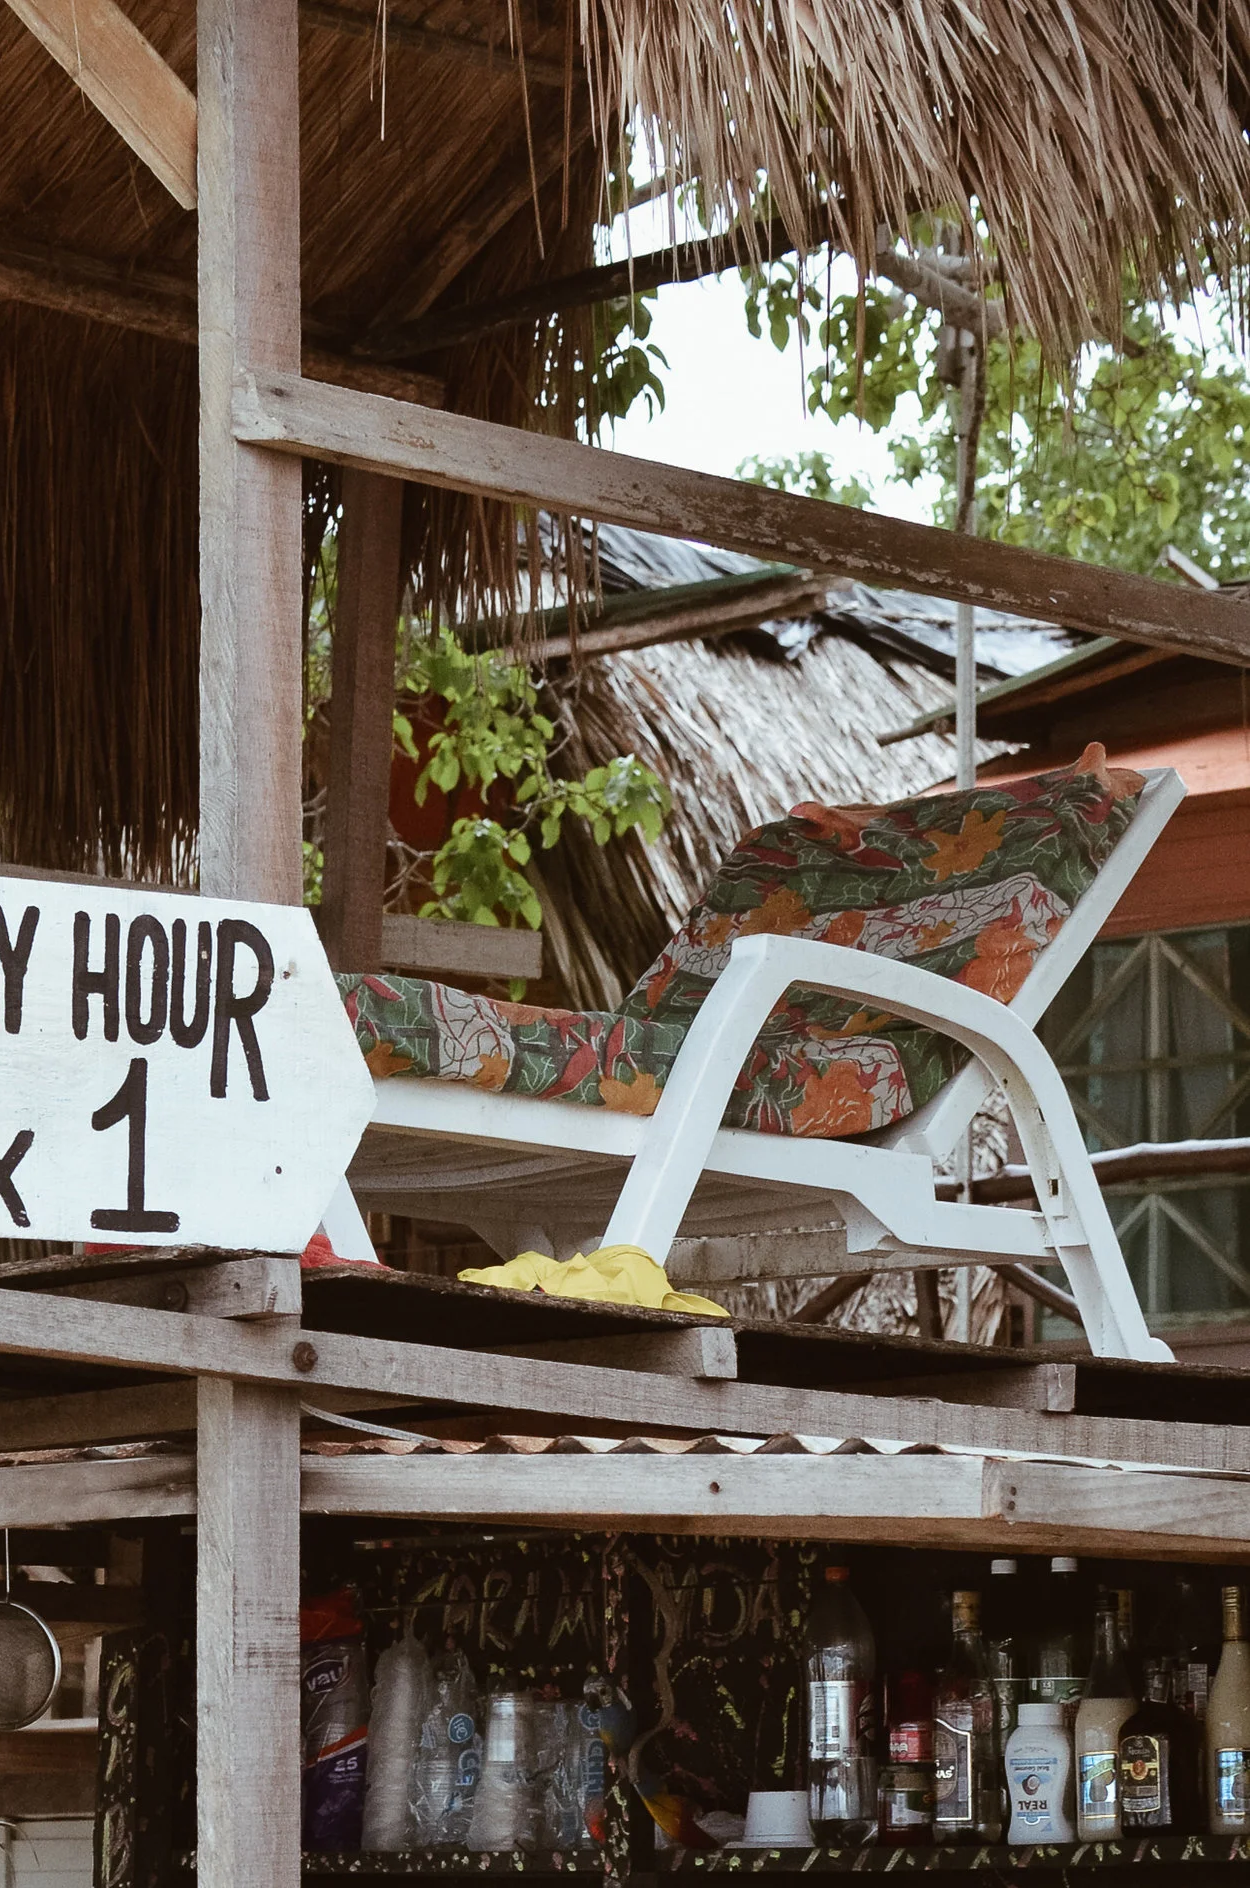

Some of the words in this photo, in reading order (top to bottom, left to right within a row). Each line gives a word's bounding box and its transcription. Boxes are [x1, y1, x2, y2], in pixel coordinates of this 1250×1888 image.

[72, 909, 275, 1102] HOUR
[91, 1057, 180, 1233] 1
[334, 1756, 358, 1771] 25
[1018, 1800, 1048, 1810] REAL
